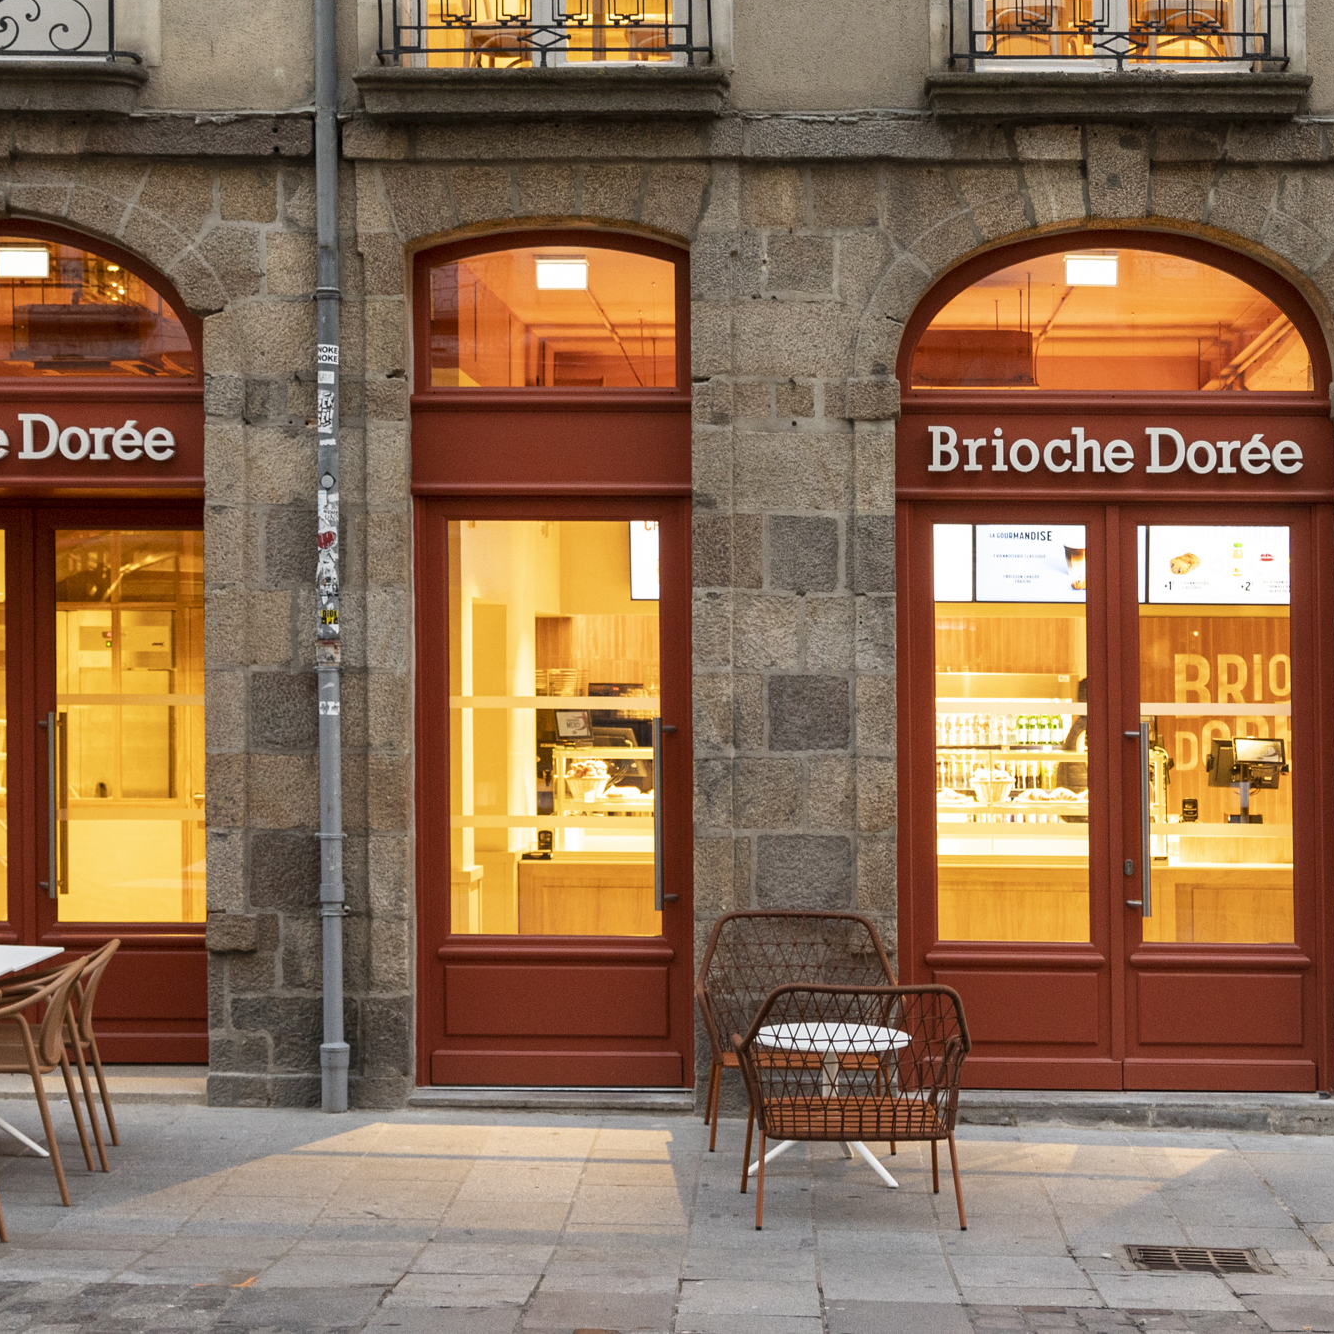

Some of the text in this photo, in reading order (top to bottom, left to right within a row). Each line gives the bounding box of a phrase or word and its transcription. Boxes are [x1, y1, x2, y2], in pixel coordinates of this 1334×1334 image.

[18, 413, 176, 461] Dorée
[928, 425, 1304, 475] Brioche Dorée
[997, 531, 1053, 542] GOURMANDISE
